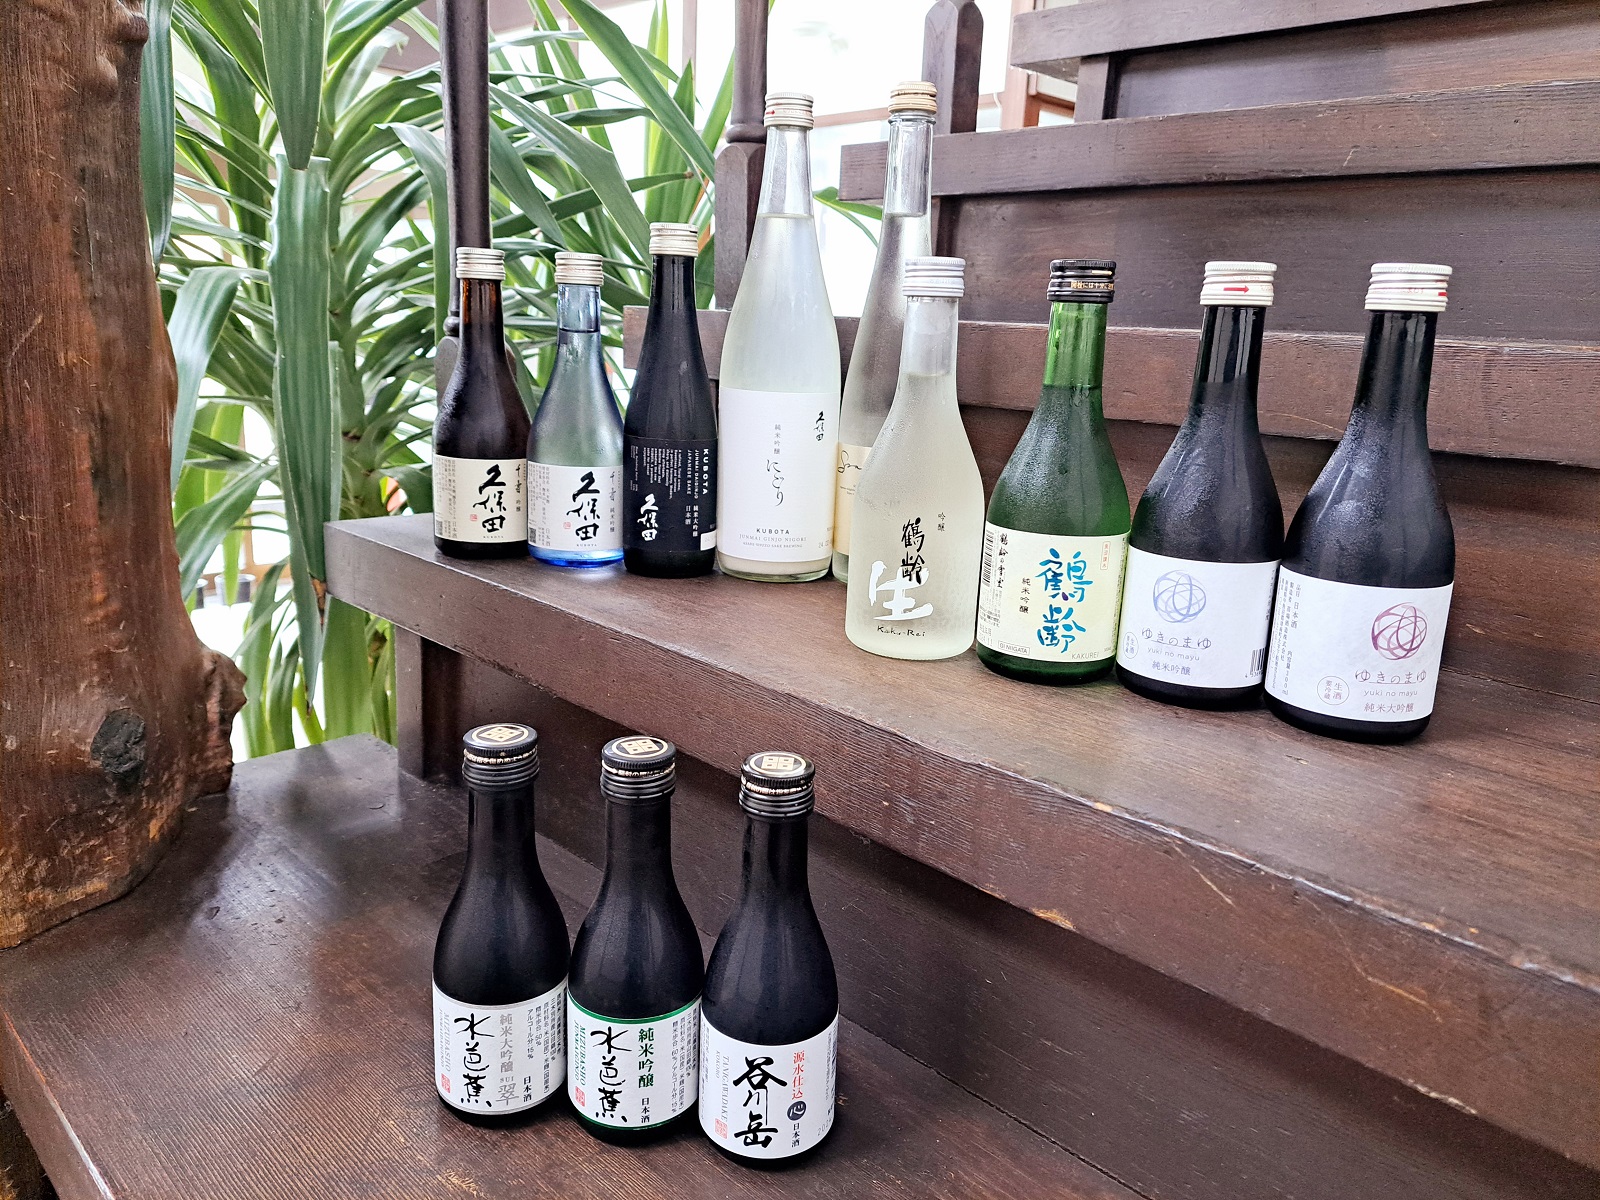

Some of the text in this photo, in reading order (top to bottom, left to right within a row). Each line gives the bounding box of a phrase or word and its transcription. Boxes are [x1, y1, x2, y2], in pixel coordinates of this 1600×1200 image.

[774, 424, 782, 454] 純米吟醸
[814, 411, 825, 442] 久保田
[766, 459, 784, 506] にごり
[472, 464, 506, 532] 久保田
[566, 471, 600, 541] 久保田
[637, 494, 658, 541] 久保田
[938, 512, 946, 532] 吟醸
[901, 517, 925, 584] 鶴齢
[868, 560, 934, 620] 生
[1019, 578, 1031, 614] 純米吟醸
[1035, 548, 1094, 654] 鶴齢
[1290, 602, 1300, 628] 日本酒
[1006, 644, 1028, 654] NIIGATA
[1142, 628, 1212, 649] ゆきのまゆ
[1072, 652, 1098, 660] KAKUREI
[1152, 660, 1190, 676] 純米吟醸
[1178, 653, 1200, 662] mayu
[1332, 682, 1342, 700] 生酒
[1355, 670, 1427, 684] ゆきのまゆ
[1364, 702, 1414, 714] 純米大吟醸
[500, 1014, 514, 1073] 純米大吟醸
[638, 1027, 654, 1088] 純米吟醸
[454, 1013, 495, 1107] 水芭蕉
[590, 1026, 632, 1122] 水芭蕉
[792, 1050, 804, 1100] 源水仕込
[496, 1083, 520, 1106] 翠
[524, 1076, 532, 1102] 日本酒
[733, 1056, 788, 1148] 谷川岳
[641, 1097, 650, 1124] 日本酒
[792, 1123, 800, 1148] 日本酒
